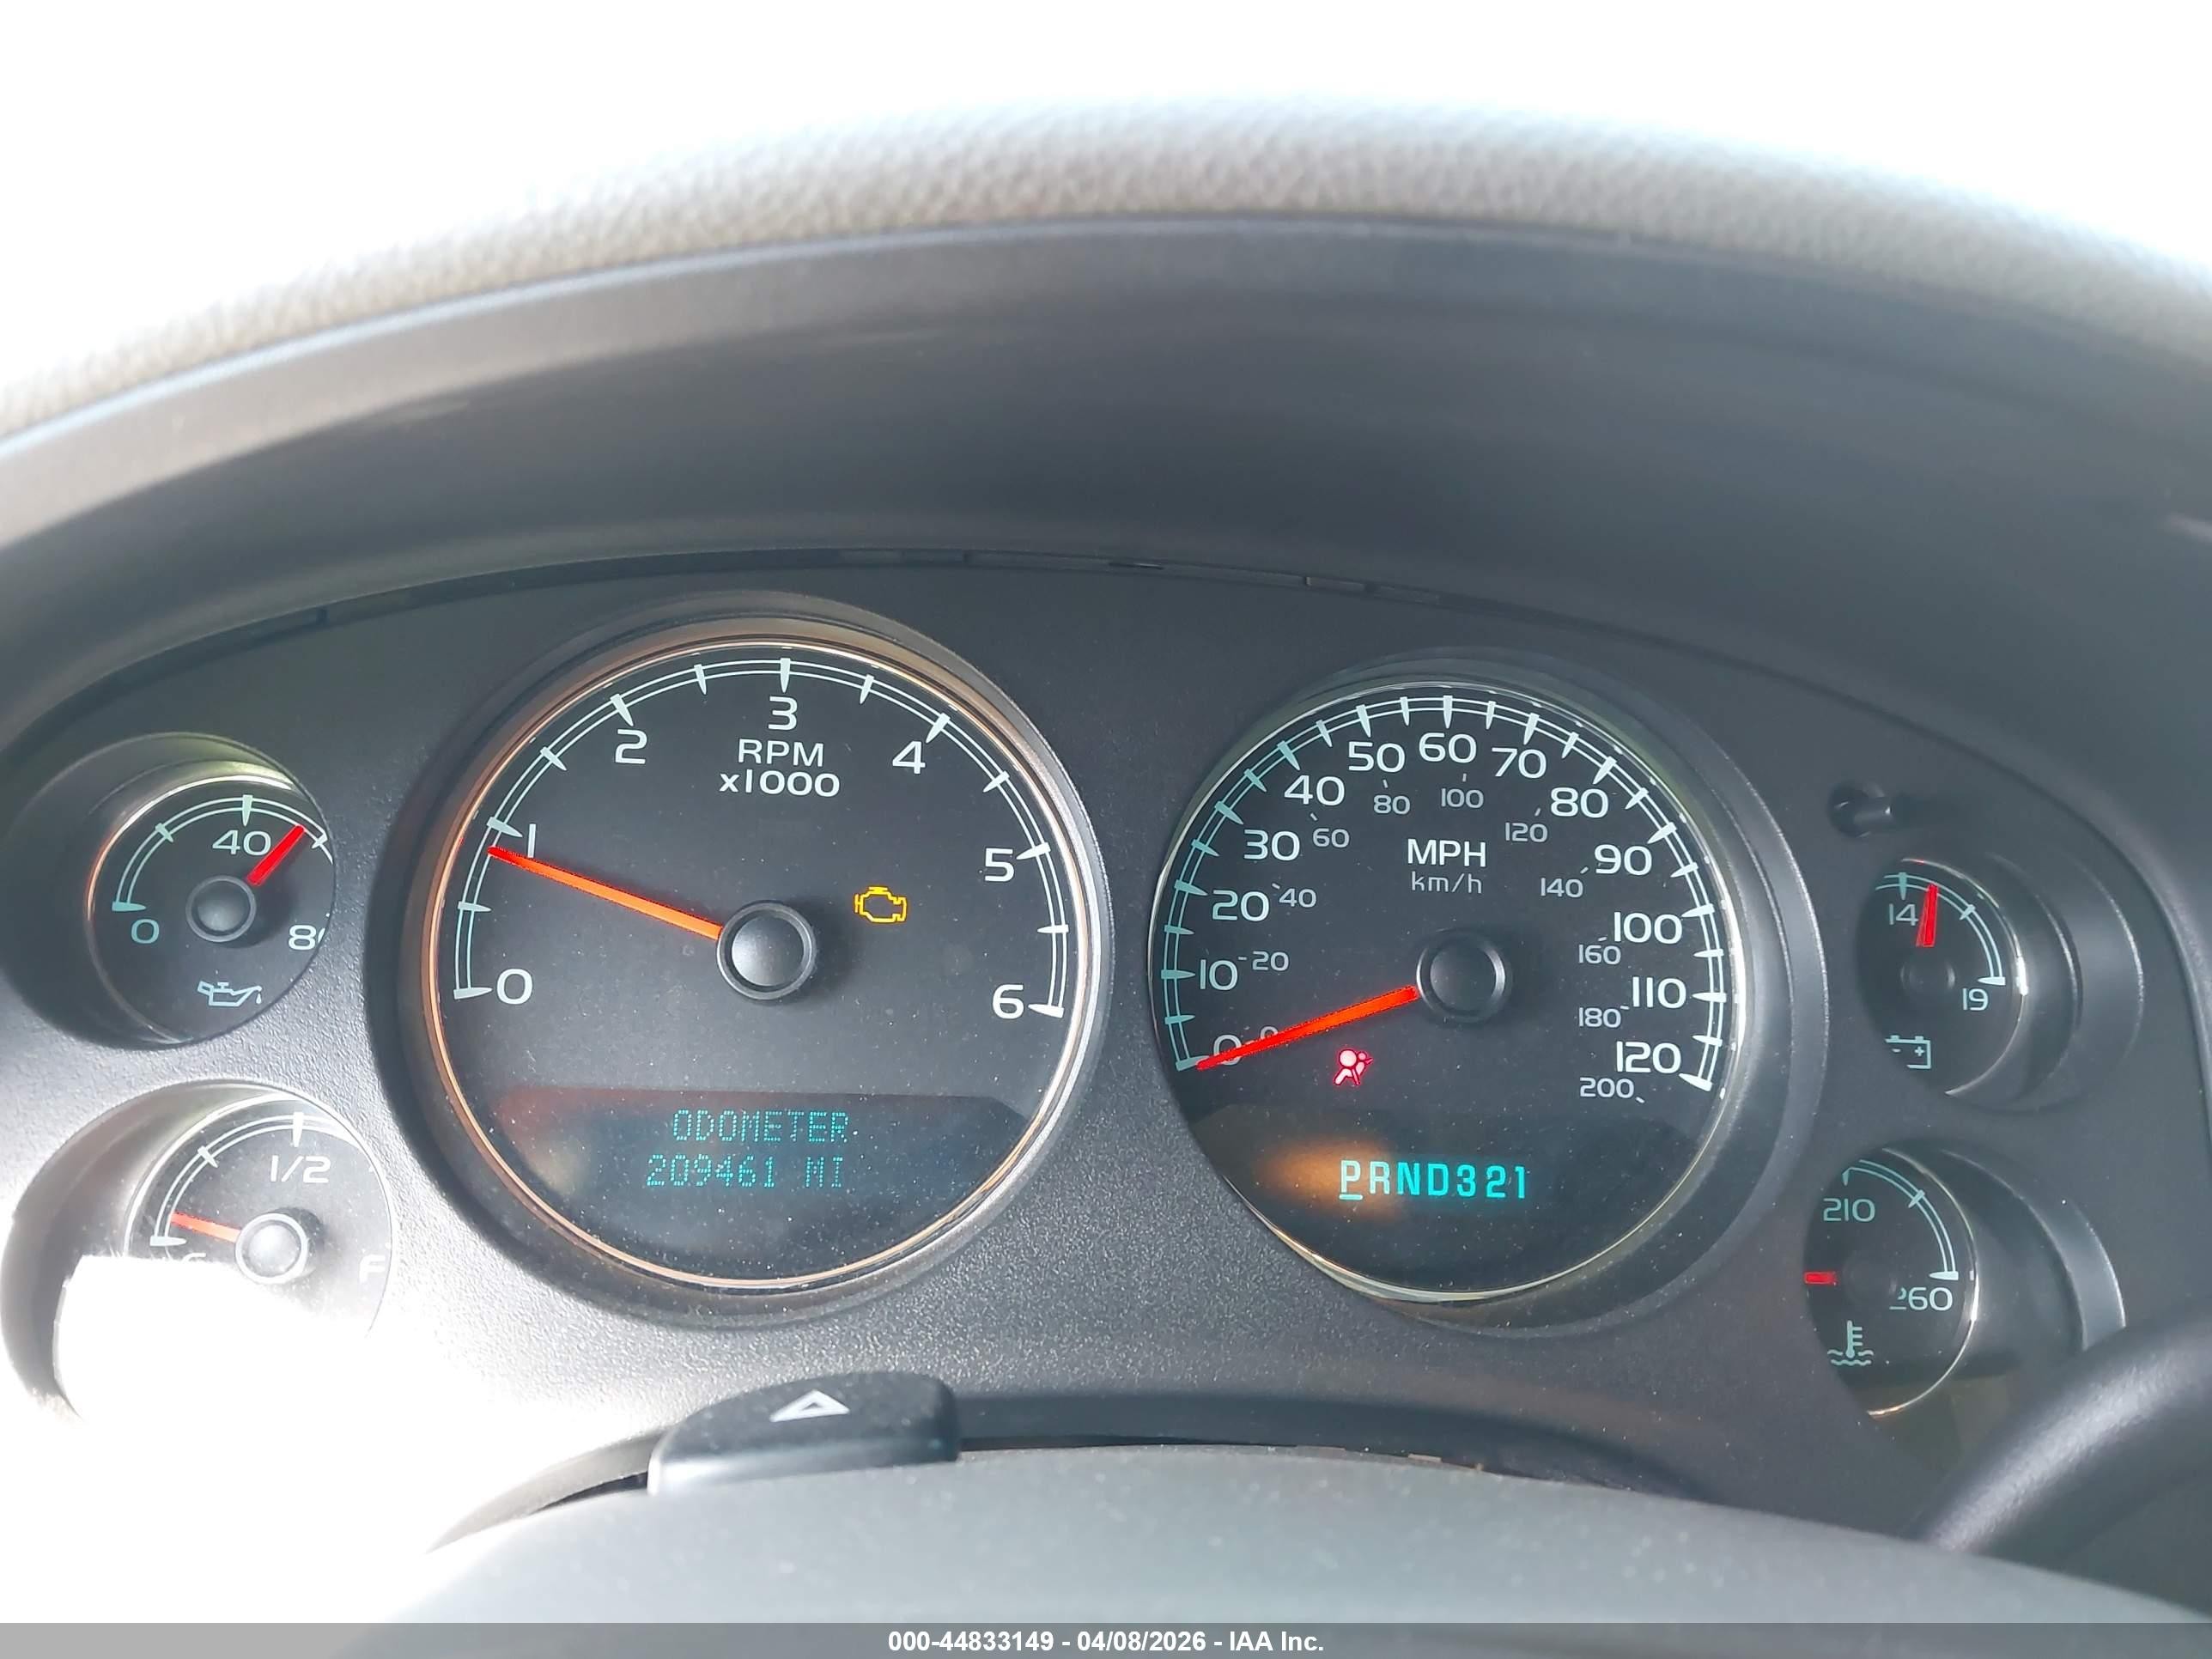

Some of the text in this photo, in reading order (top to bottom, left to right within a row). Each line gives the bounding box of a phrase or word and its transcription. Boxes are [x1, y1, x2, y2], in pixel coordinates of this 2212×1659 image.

[768, 696, 798, 731] 3
[615, 728, 647, 764] 2
[738, 738, 823, 767] RPM
[892, 740, 926, 775] 4
[1348, 741, 1406, 773] 50
[1419, 732, 1477, 763] 60
[1492, 747, 1547, 779] 70
[719, 769, 840, 798] x1000
[1284, 775, 1345, 806] 40
[1441, 787, 1484, 809] 100
[1373, 794, 1411, 815] 80
[1551, 787, 1609, 818] 80
[212, 830, 271, 856] 40
[527, 823, 537, 859] 1
[1243, 829, 1300, 861] 30
[1312, 828, 1350, 848] 60
[1505, 822, 1548, 842] 120
[984, 848, 1016, 882] 5
[1407, 838, 1486, 867] MPH
[1594, 844, 1652, 876] 90
[1412, 871, 1482, 894] km/h
[1540, 878, 1583, 898] 140
[1212, 890, 1270, 921] 20
[1278, 888, 1317, 908] 40
[1613, 911, 1683, 944] 100
[1889, 903, 1919, 927] 14
[131, 919, 160, 944] 0
[288, 924, 325, 951] 8
[1252, 951, 1289, 971] 20
[1578, 944, 1621, 965] 160
[496, 968, 533, 1005] 0
[1200, 959, 1238, 991] 10
[992, 984, 1024, 1019] 6
[1632, 976, 1686, 1009] 110
[1962, 988, 1989, 1011] 19
[1578, 1006, 1622, 1028] 180
[1616, 1041, 1682, 1074] 120
[1579, 1077, 1634, 1098] 200
[673, 1109, 848, 1143] ODOMETER
[270, 1155, 331, 1184] 1/2
[647, 1153, 843, 1188] 209461 MI
[1823, 1198, 1875, 1222] 210
[358, 1254, 386, 1283] F
